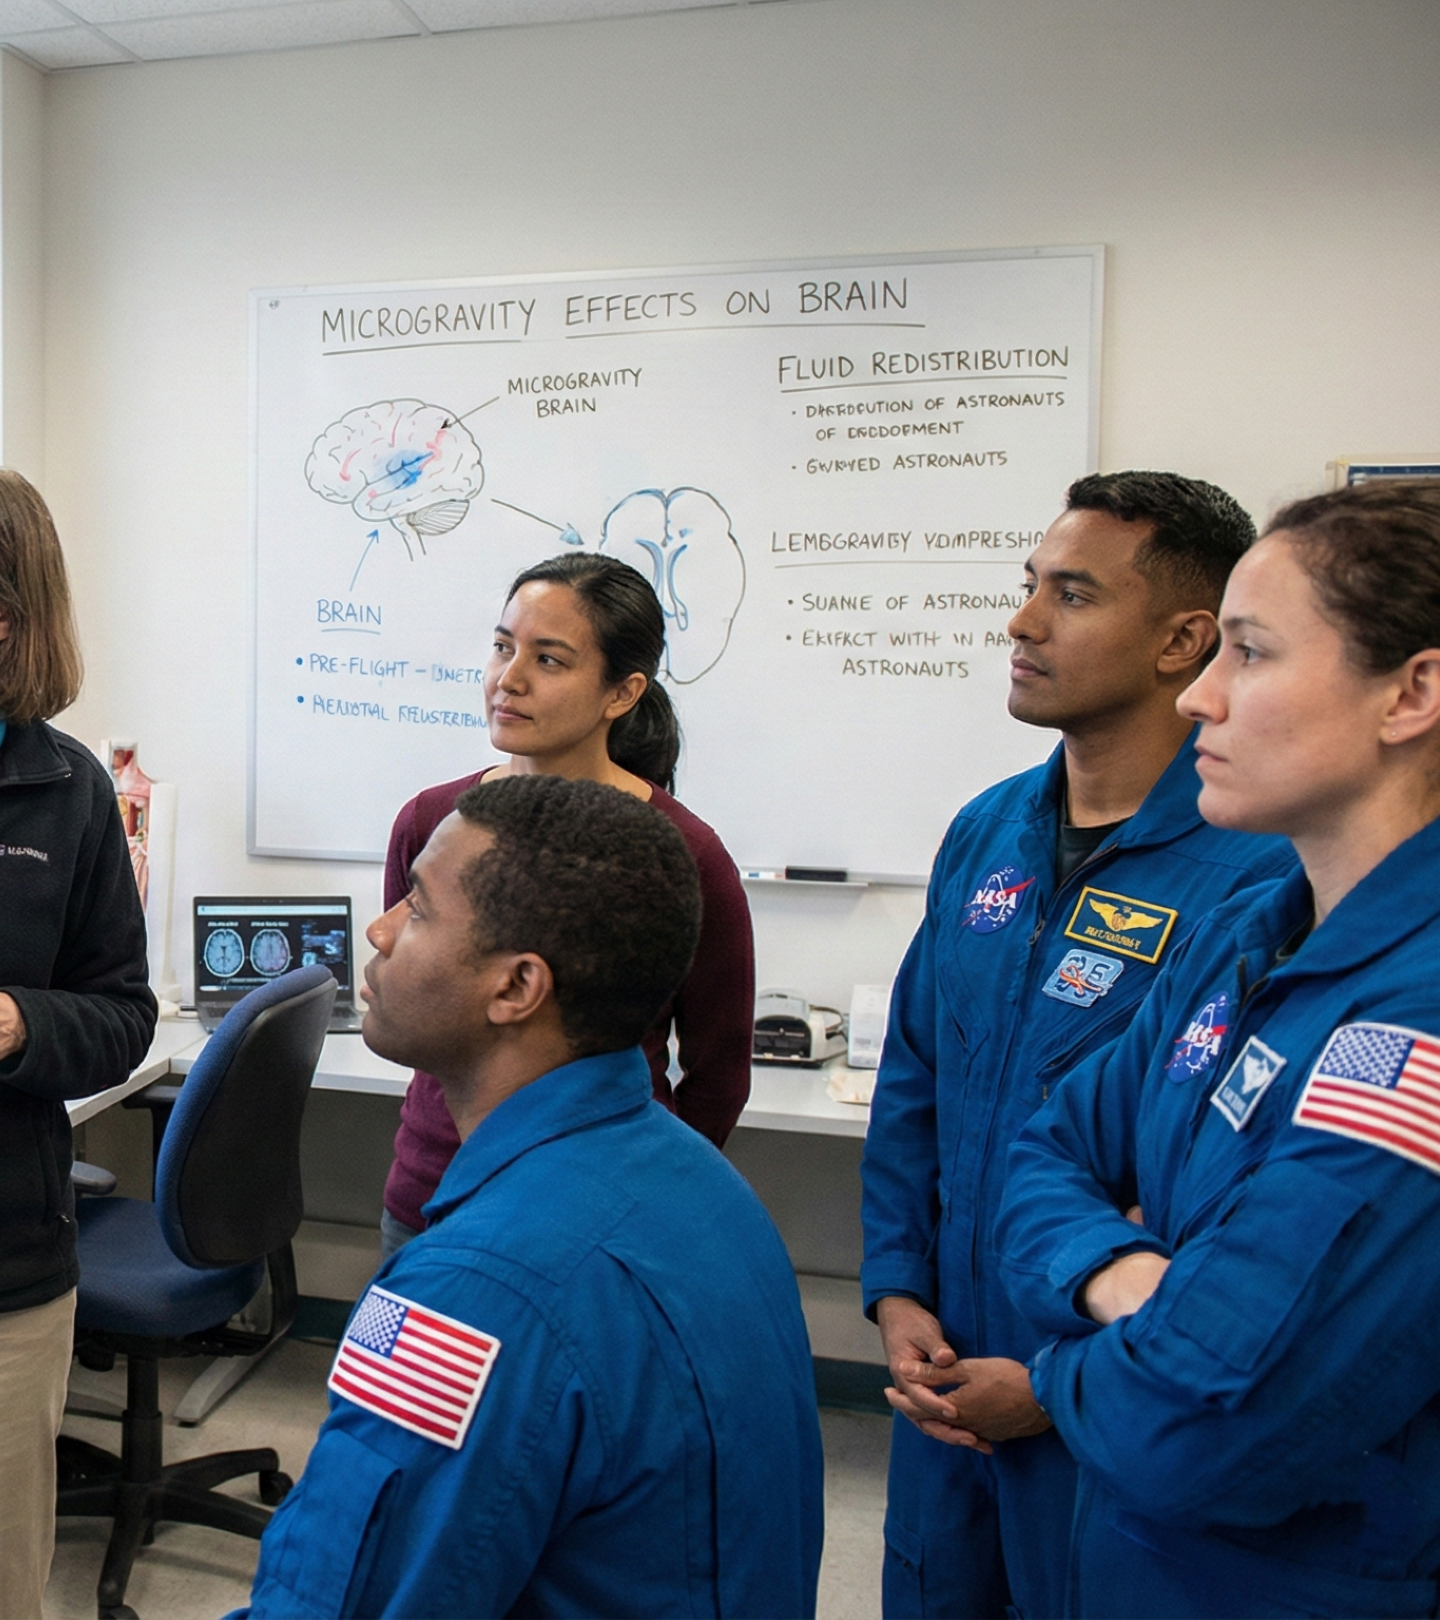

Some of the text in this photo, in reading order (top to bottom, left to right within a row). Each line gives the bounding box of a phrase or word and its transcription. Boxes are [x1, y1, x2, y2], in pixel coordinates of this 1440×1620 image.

[322, 277, 908, 343] MICROGRAVITY EFFECTS ON BRAIN
[778, 345, 1069, 384] FLUID REDISTRIBUTION
[507, 367, 642, 395] MICROGRAVITY
[536, 397, 597, 418] BRAIN
[924, 397, 945, 411] OF
[956, 391, 1065, 410] ASTRONAUTS
[815, 427, 836, 442] OF
[892, 451, 1008, 471] ASTRONAUTS
[317, 599, 382, 626] BRAIN
[885, 595, 909, 611] OF
[922, 593, 1023, 611] ASTRONAU
[310, 653, 410, 679] PRE-FLIGHT
[842, 657, 970, 678] ASTRONAUTS
[971, 888, 1018, 909] NASA
